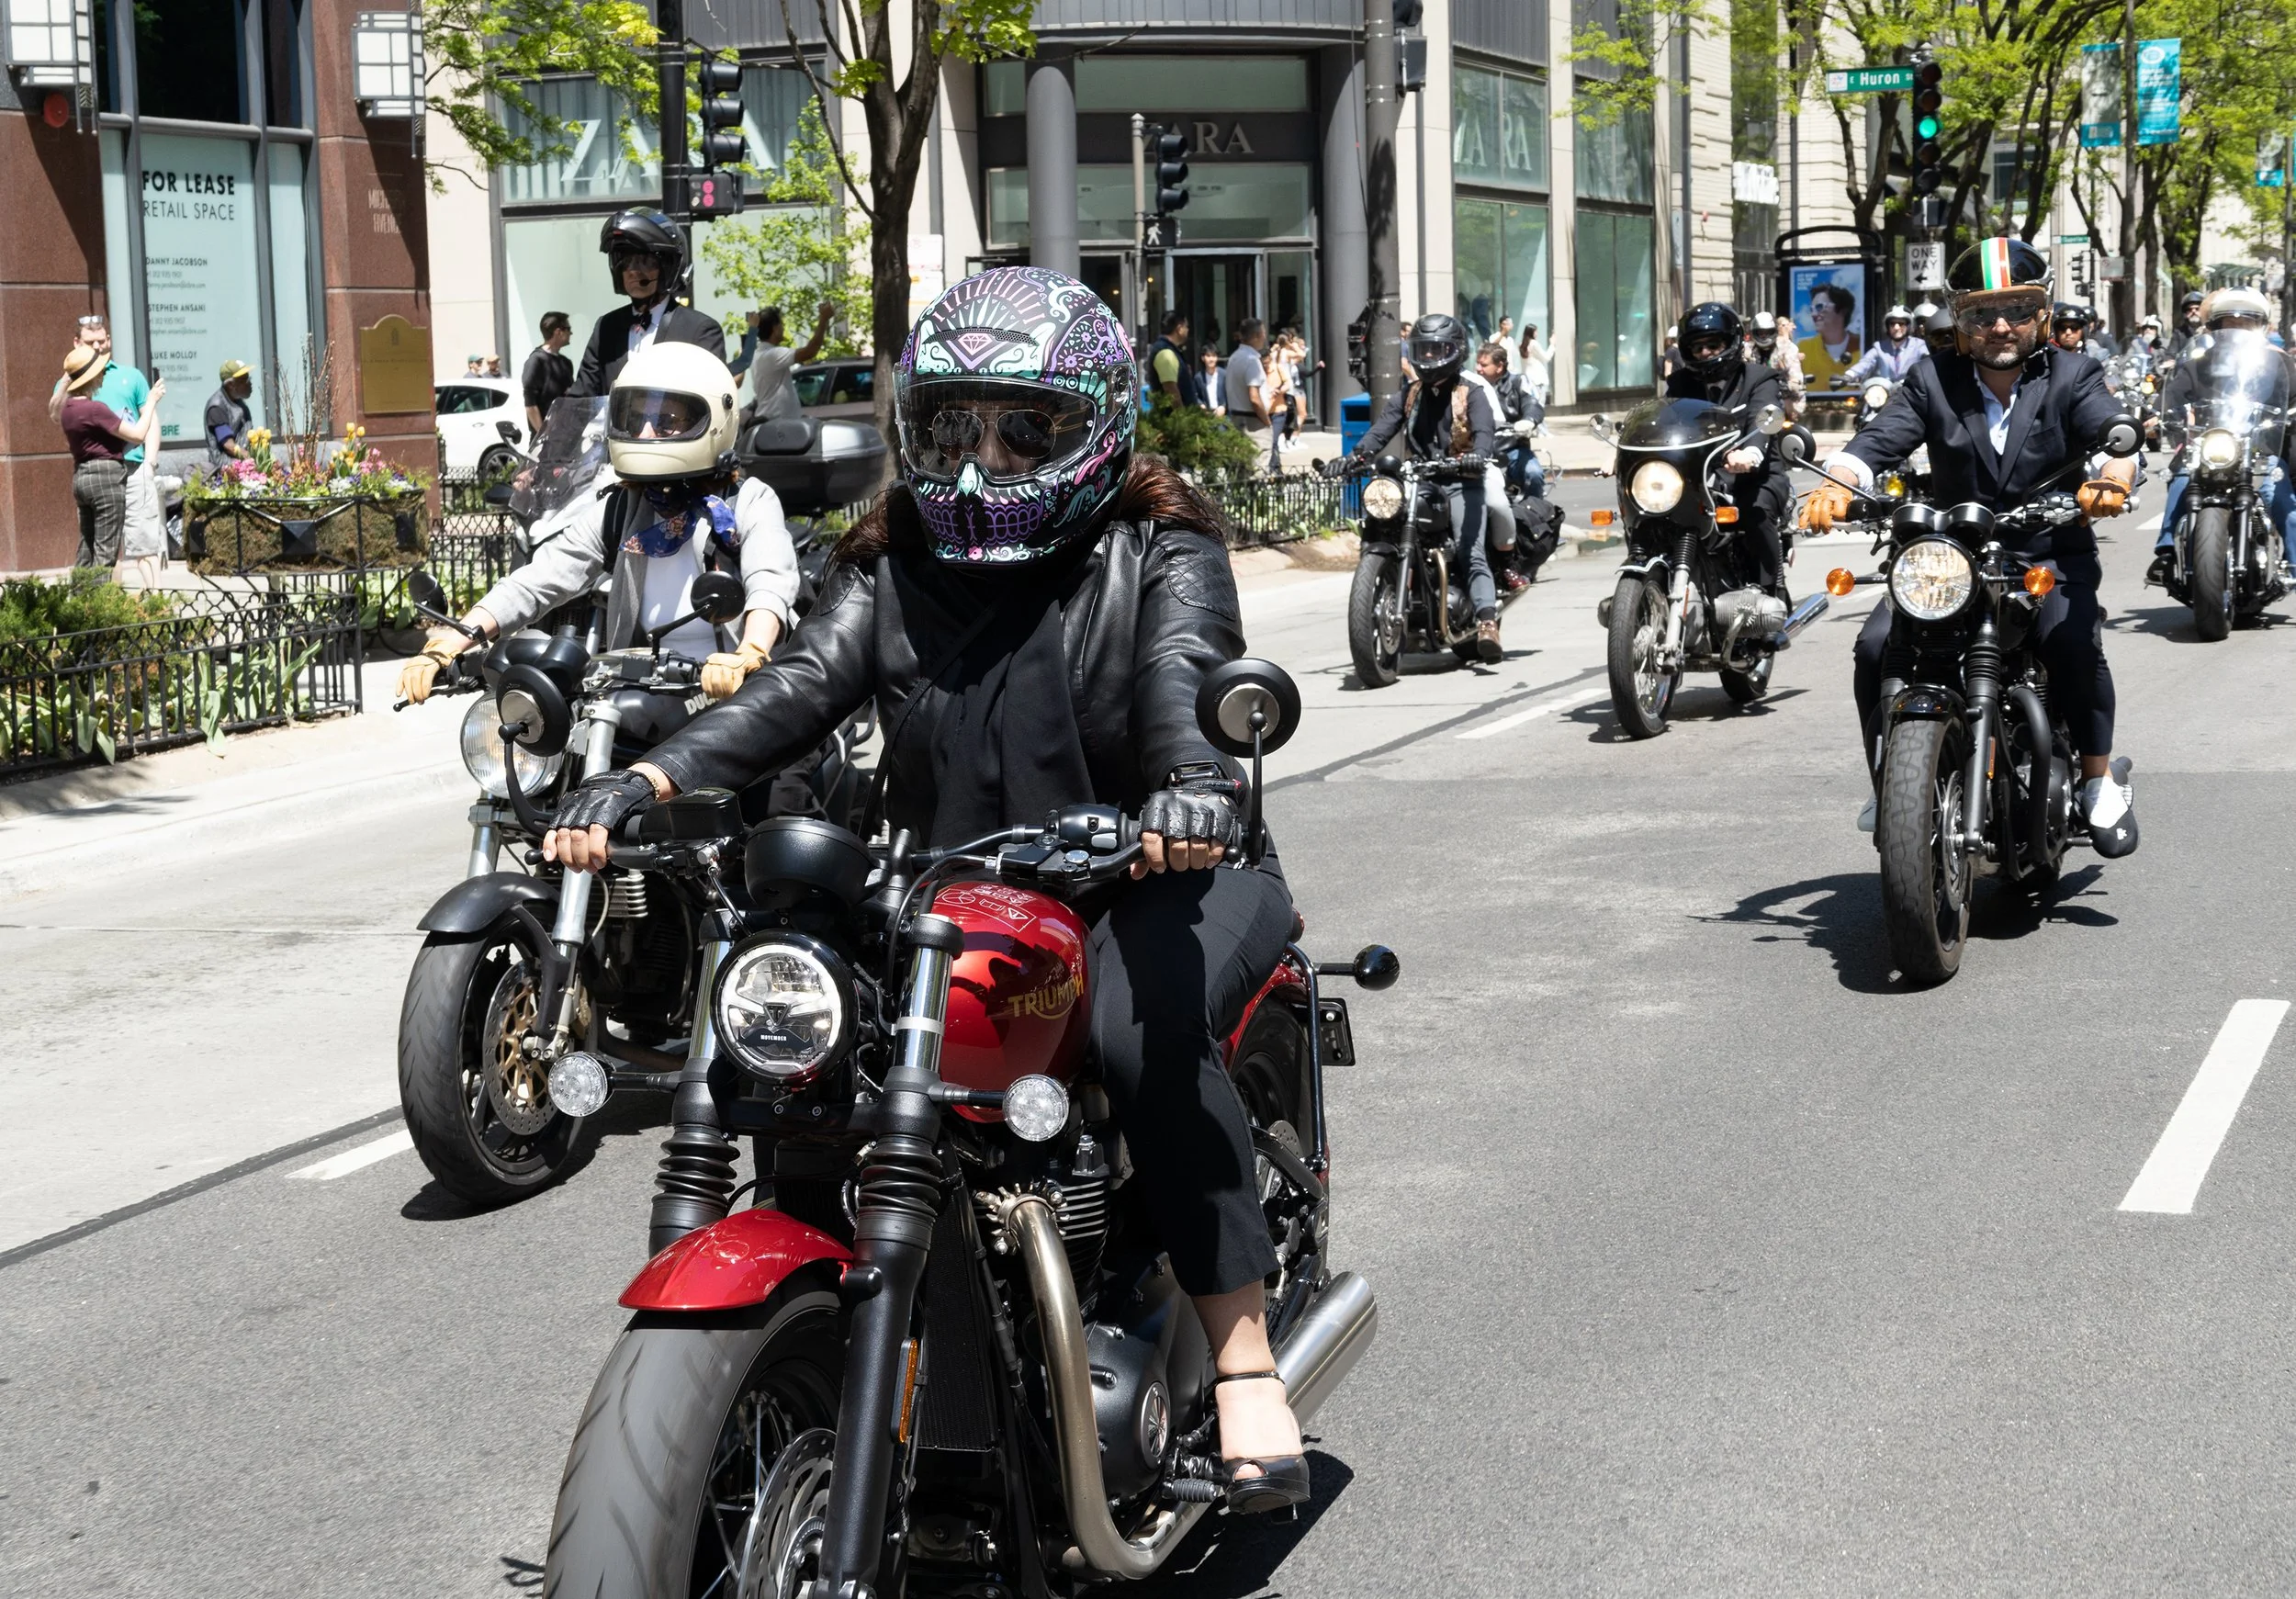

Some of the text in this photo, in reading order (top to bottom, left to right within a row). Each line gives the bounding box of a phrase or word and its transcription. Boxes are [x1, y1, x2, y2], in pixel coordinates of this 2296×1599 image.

[1860, 72, 1900, 86] Huron
[141, 171, 235, 196] FOR LEASE
[143, 199, 235, 220] RETAIL SPACE
[1911, 247, 1937, 258] ONE
[146, 257, 208, 266] DANNY JACOBSON
[1911, 260, 1938, 271] WAY
[148, 303, 206, 312] STEPHEN ANSANI
[151, 351, 197, 359] LUKE MOLLOY
[161, 424, 180, 436] BRE
[1007, 973, 1085, 1019] TRIUMPH
